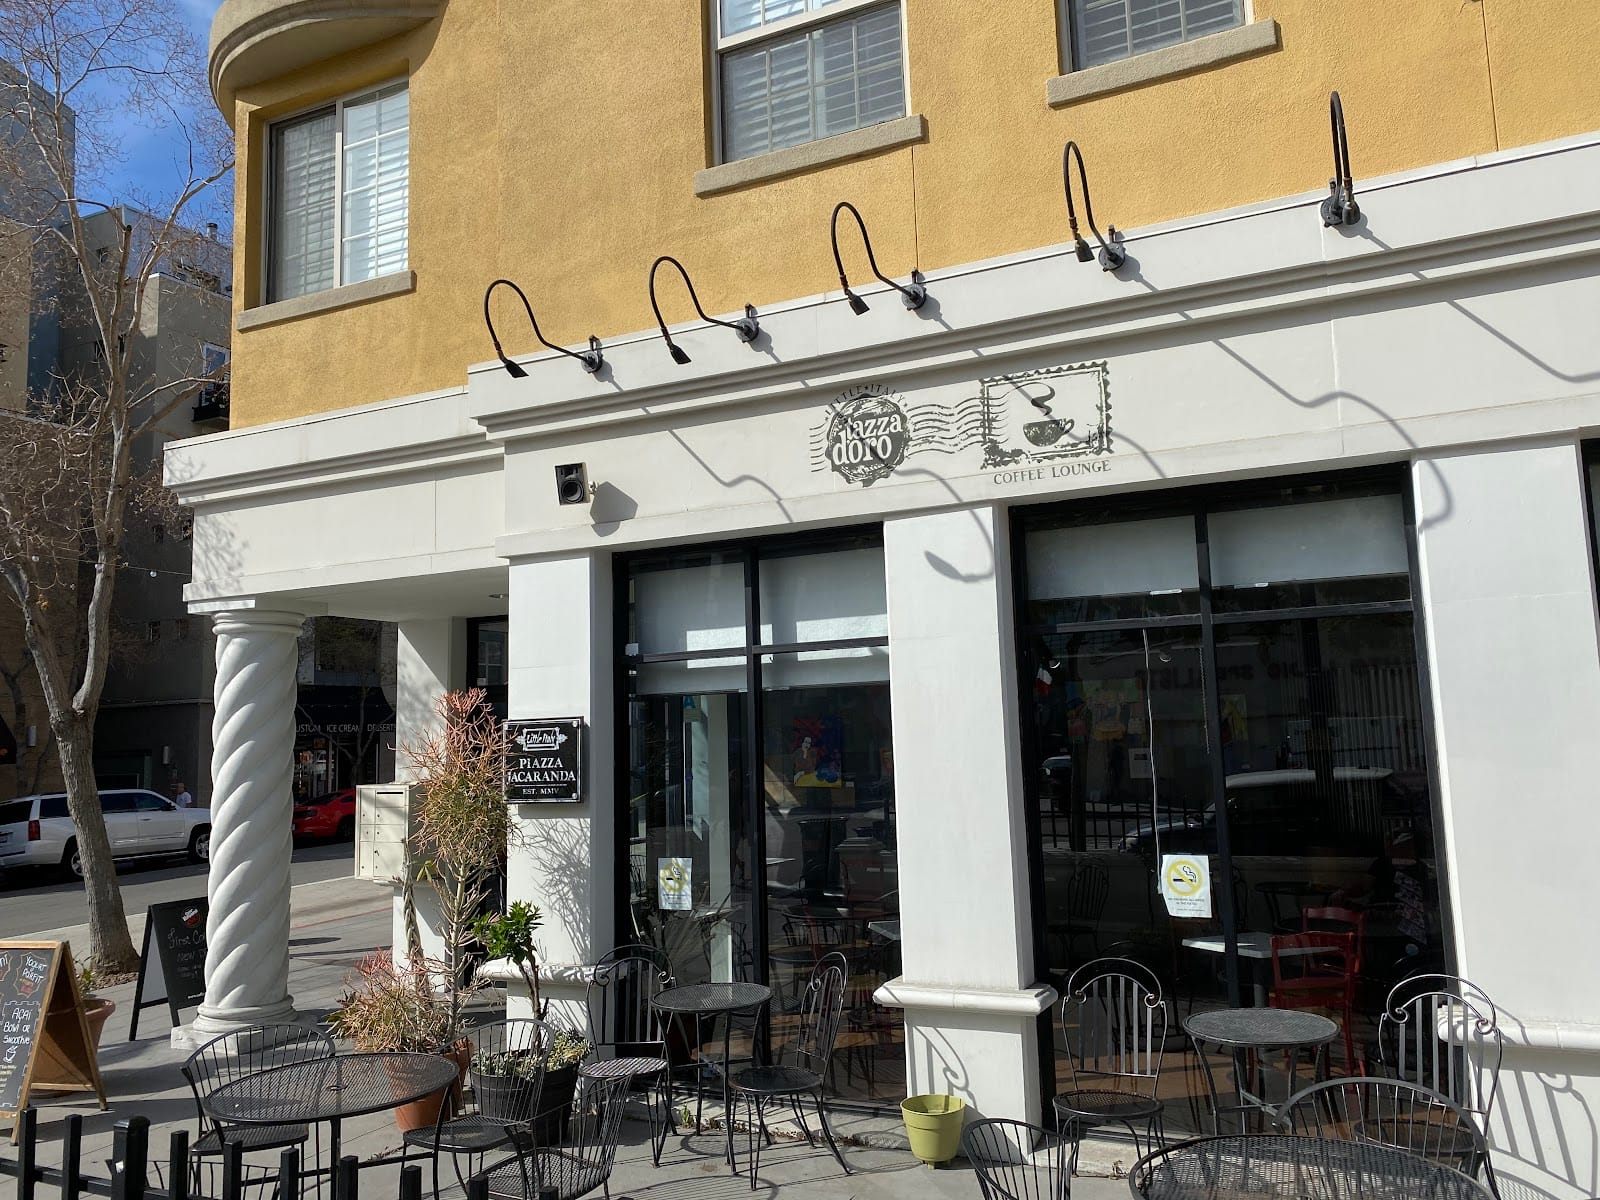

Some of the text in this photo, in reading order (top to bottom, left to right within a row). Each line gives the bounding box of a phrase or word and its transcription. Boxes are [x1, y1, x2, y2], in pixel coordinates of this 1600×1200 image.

[825, 384, 904, 416] LITTLE ITALY
[993, 460, 1111, 485] COFFEE LOUNGE
[326, 724, 337, 733] ICE
[519, 757, 563, 768] PIAZZA
[507, 770, 576, 783] JACARANDA
[540, 787, 560, 795] MMV
